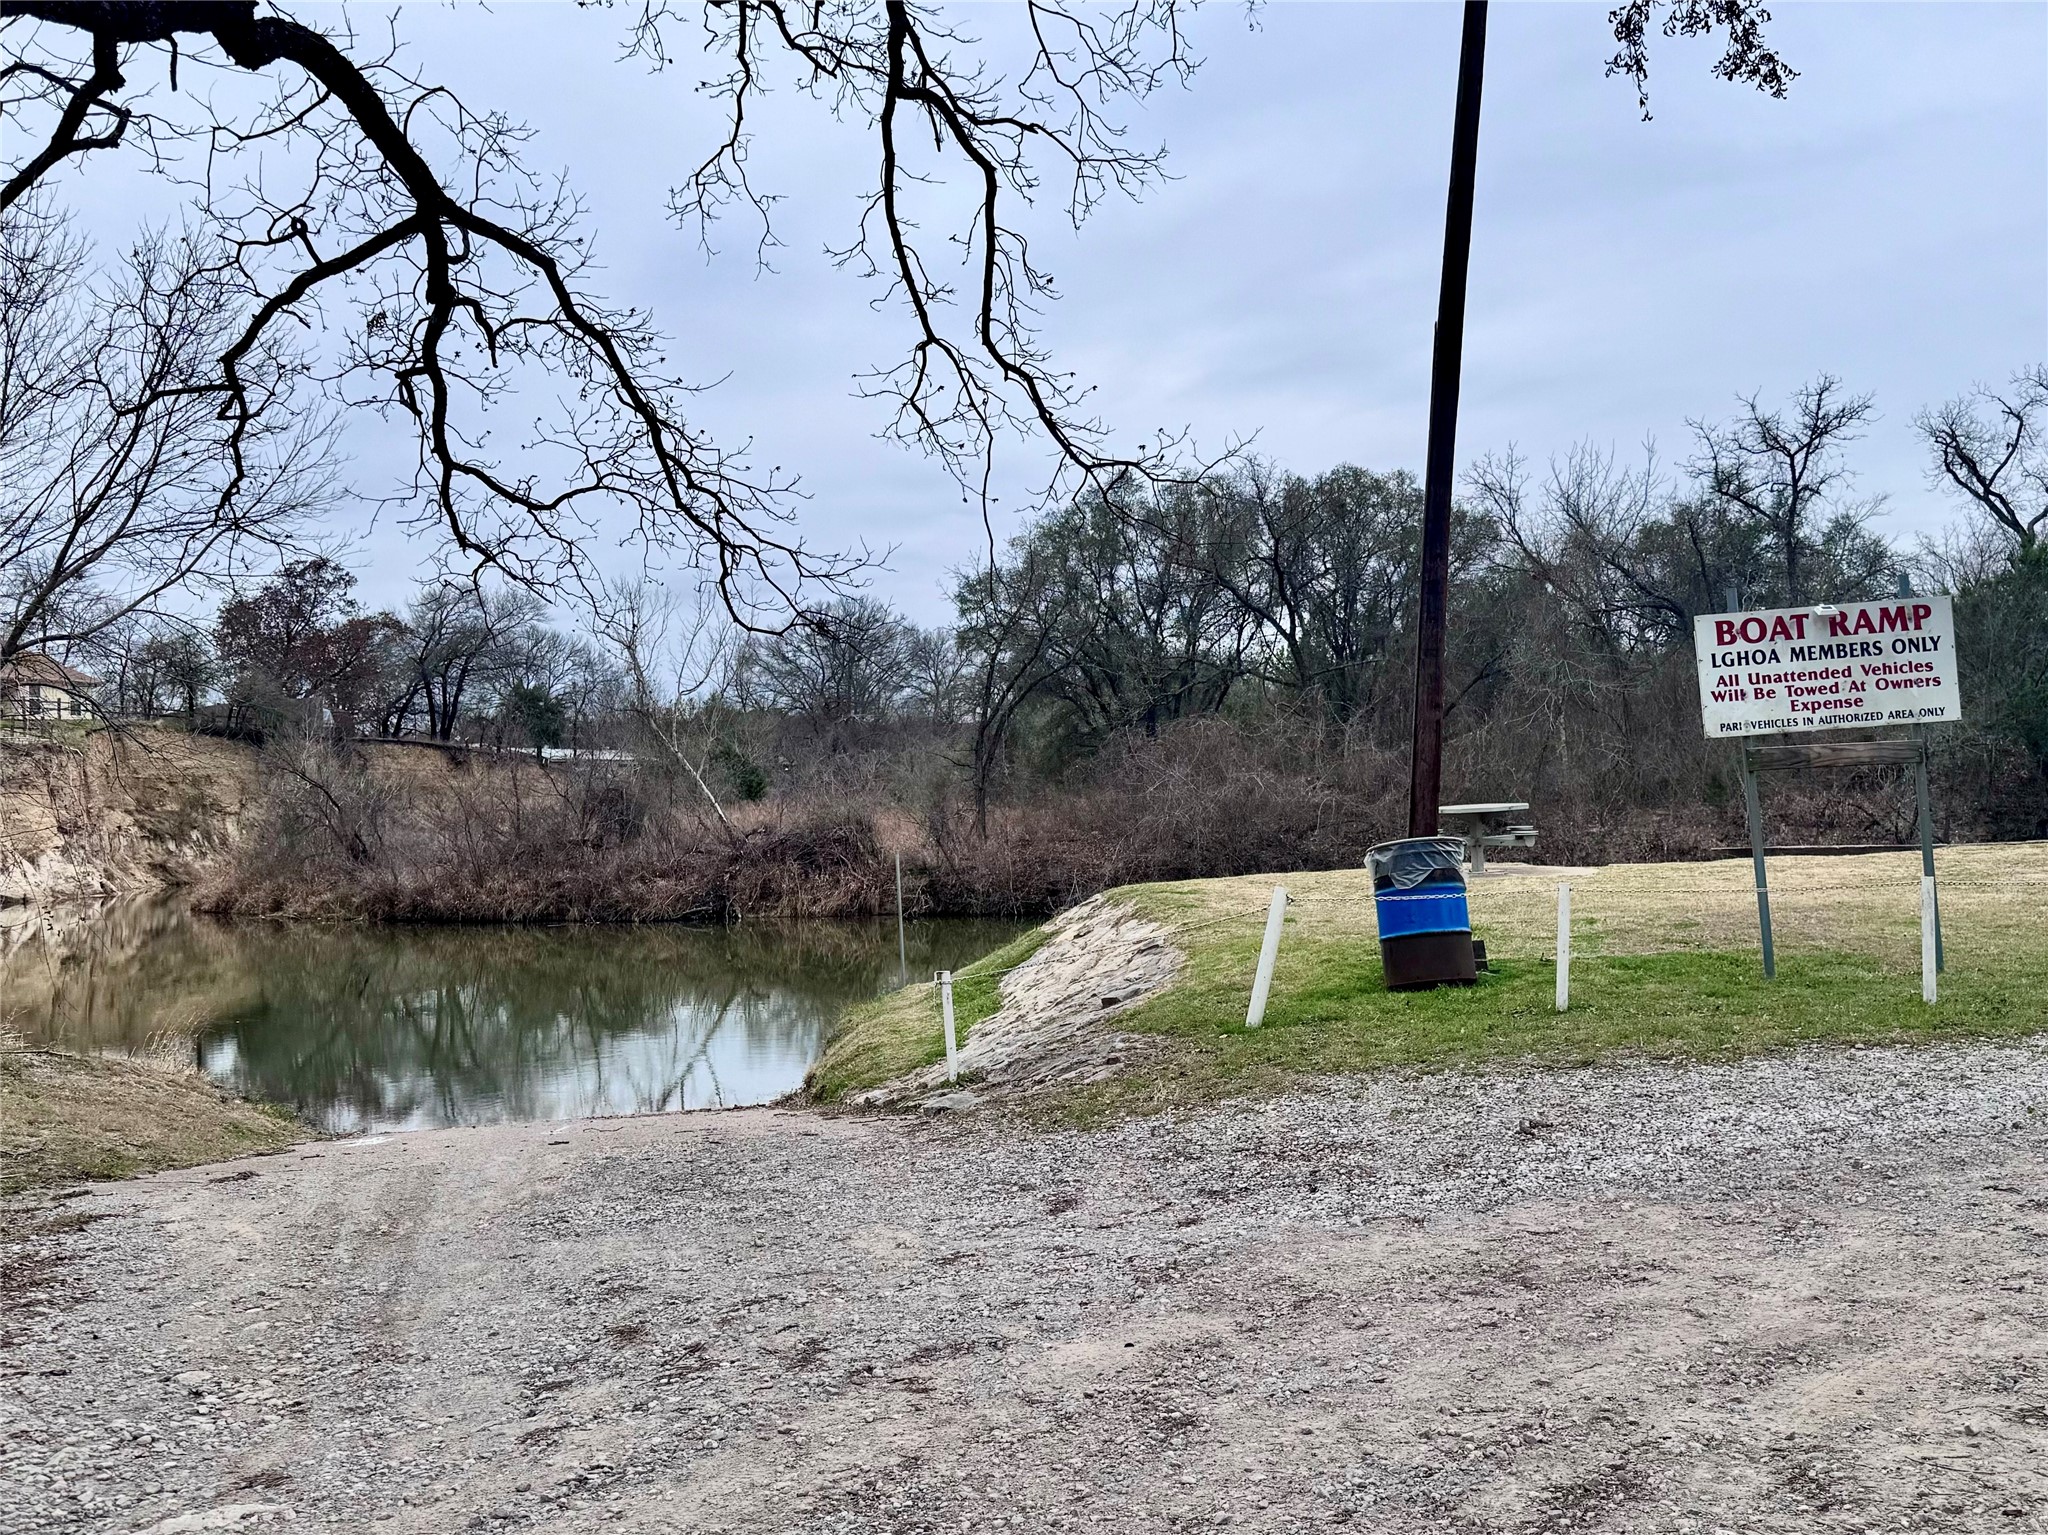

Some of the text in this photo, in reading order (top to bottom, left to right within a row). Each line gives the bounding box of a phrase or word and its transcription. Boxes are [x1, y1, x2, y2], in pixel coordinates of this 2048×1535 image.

[1714, 604, 1932, 646] BOAT RAMP
[1711, 636, 1941, 668] LGHOA MEMBERS ONLY
[1711, 674, 1941, 702] Will Be Towed At Owners
[1716, 661, 1934, 688] All Unattended Vehicles
[1751, 718, 1798, 730] VEHICLES
[1803, 717, 1813, 726] IN
[1818, 712, 1883, 725] AUTHORIZED
[1888, 710, 1914, 719] AREA
[1919, 707, 1945, 717] ONLY
[1790, 697, 1864, 714] Expense
